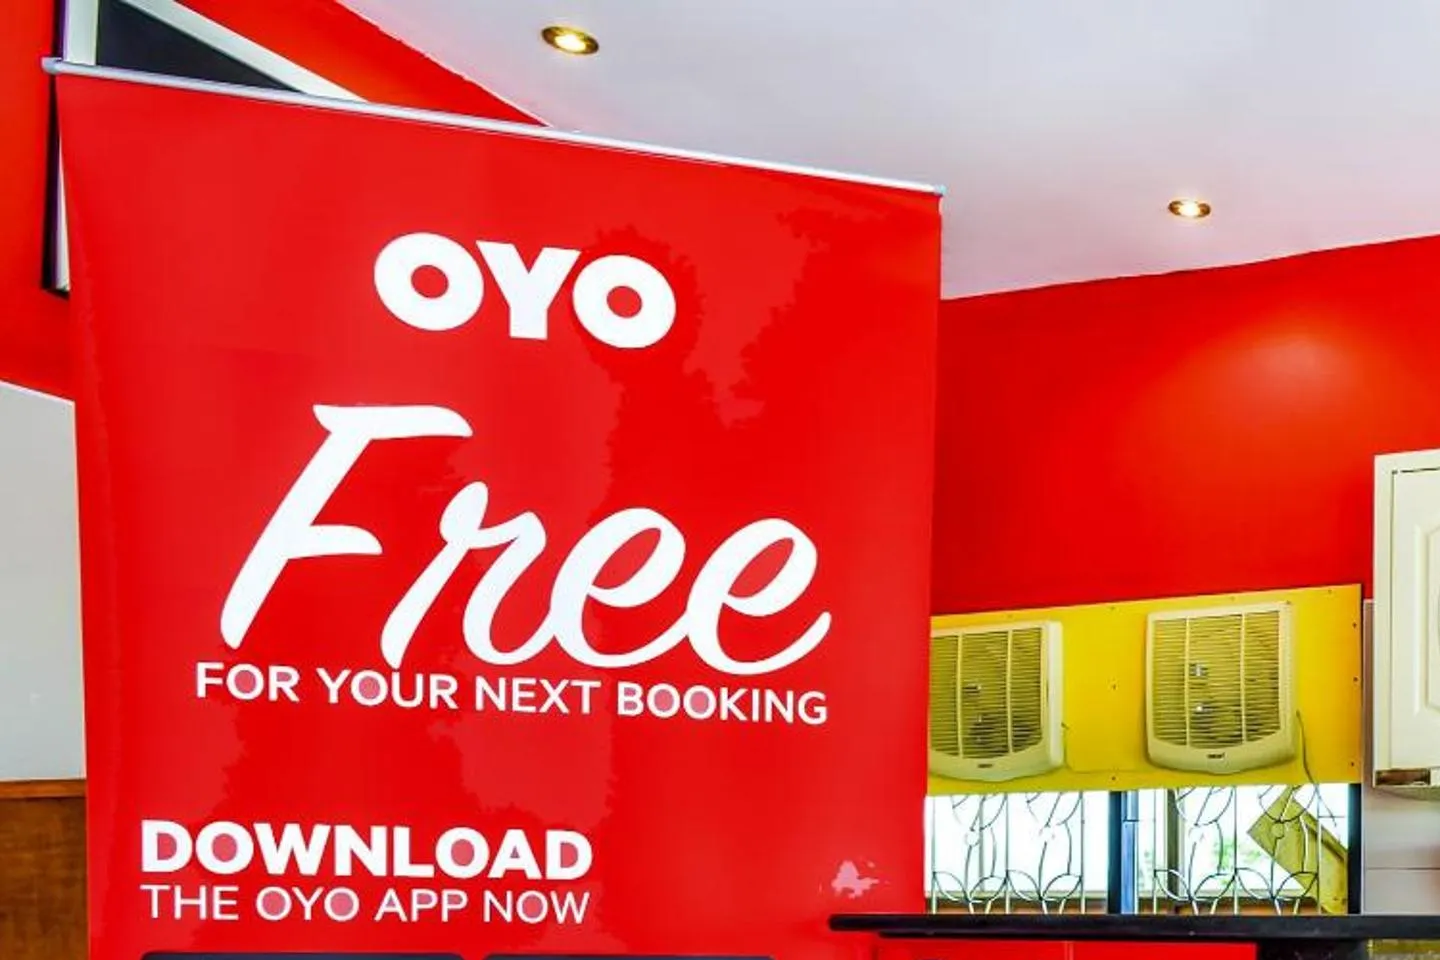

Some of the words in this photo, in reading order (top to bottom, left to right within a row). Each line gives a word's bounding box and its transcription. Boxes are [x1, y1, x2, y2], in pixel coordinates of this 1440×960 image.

[374, 232, 676, 348] OYO
[220, 404, 832, 676] Free
[196, 661, 300, 702] FOR
[321, 668, 458, 710] YOUR
[475, 675, 601, 714] NEXT
[617, 682, 828, 725] BOOKING
[140, 820, 592, 879] DOWNLOAD
[140, 885, 239, 921] THE
[255, 886, 360, 922] OYO
[374, 888, 468, 923] APP
[483, 889, 590, 925] NOW
